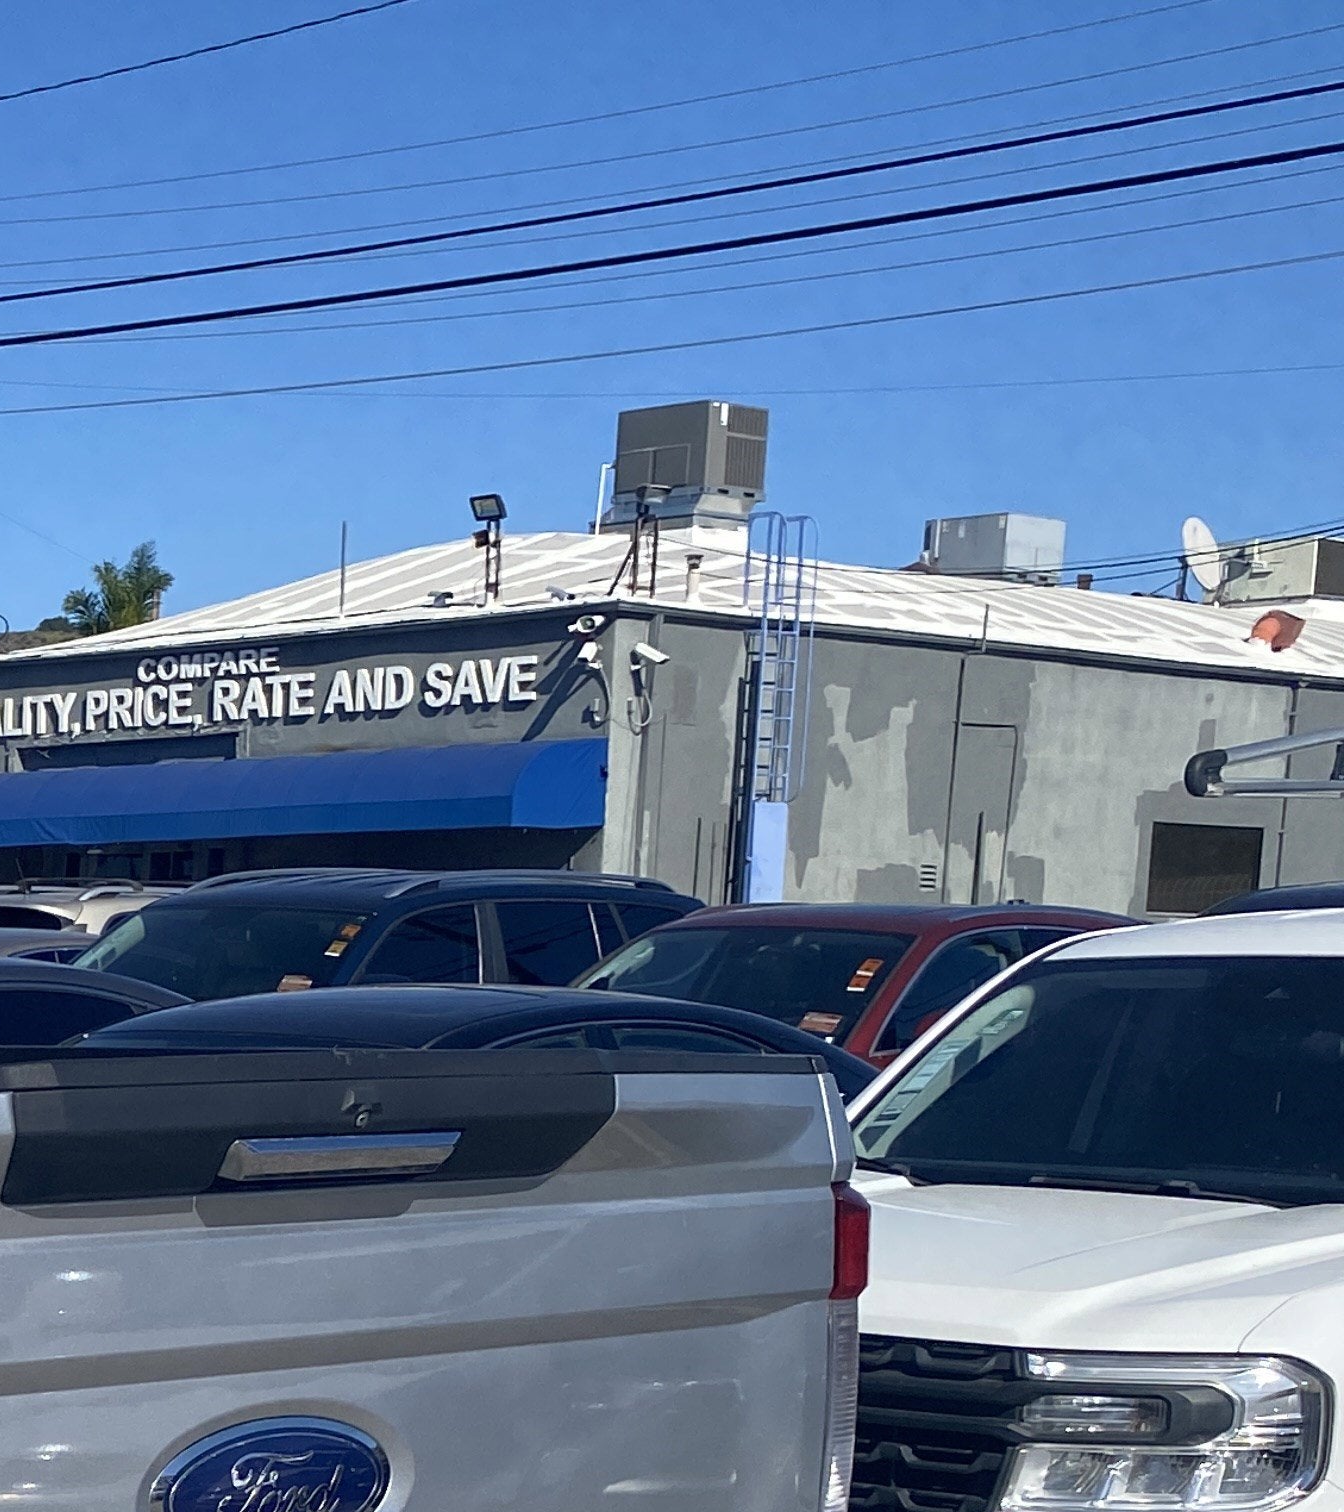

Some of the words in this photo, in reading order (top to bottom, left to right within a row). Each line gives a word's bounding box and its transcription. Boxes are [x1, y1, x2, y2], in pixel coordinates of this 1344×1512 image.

[85, 682, 203, 731] PRICE,
[213, 672, 316, 721] RATE
[323, 665, 415, 714] AND
[424, 655, 538, 707] SAVE
[137, 647, 280, 683] COMPARE
